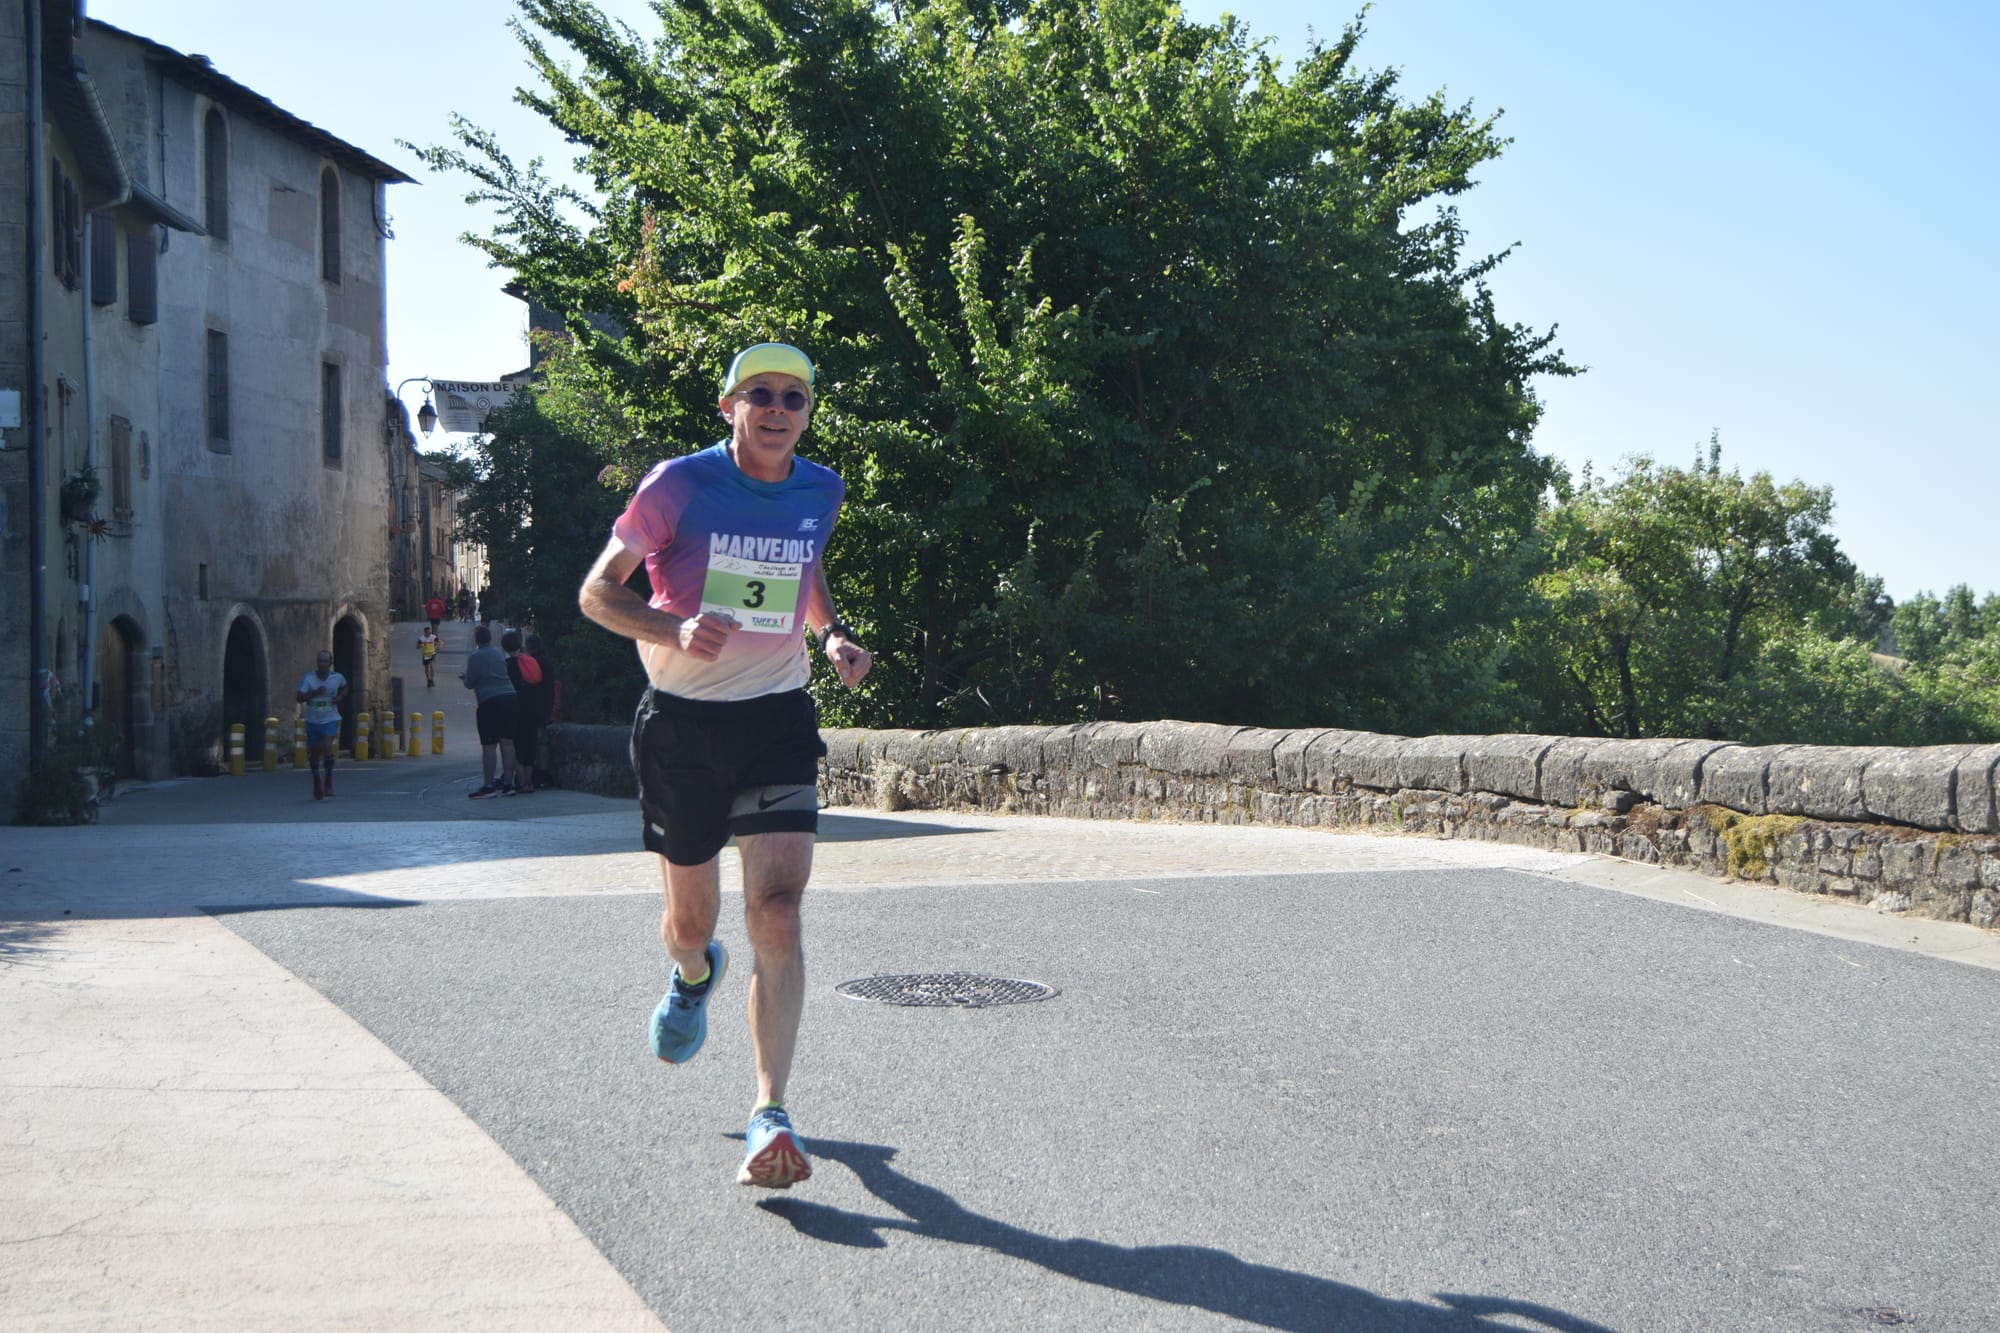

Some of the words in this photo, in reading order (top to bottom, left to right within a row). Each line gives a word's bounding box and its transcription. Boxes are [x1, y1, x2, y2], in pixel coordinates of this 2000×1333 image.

[436, 382, 490, 393] MAISON
[493, 383, 510, 392] DE
[710, 533, 814, 563] MARVEJOLS
[743, 581, 766, 608] 3
